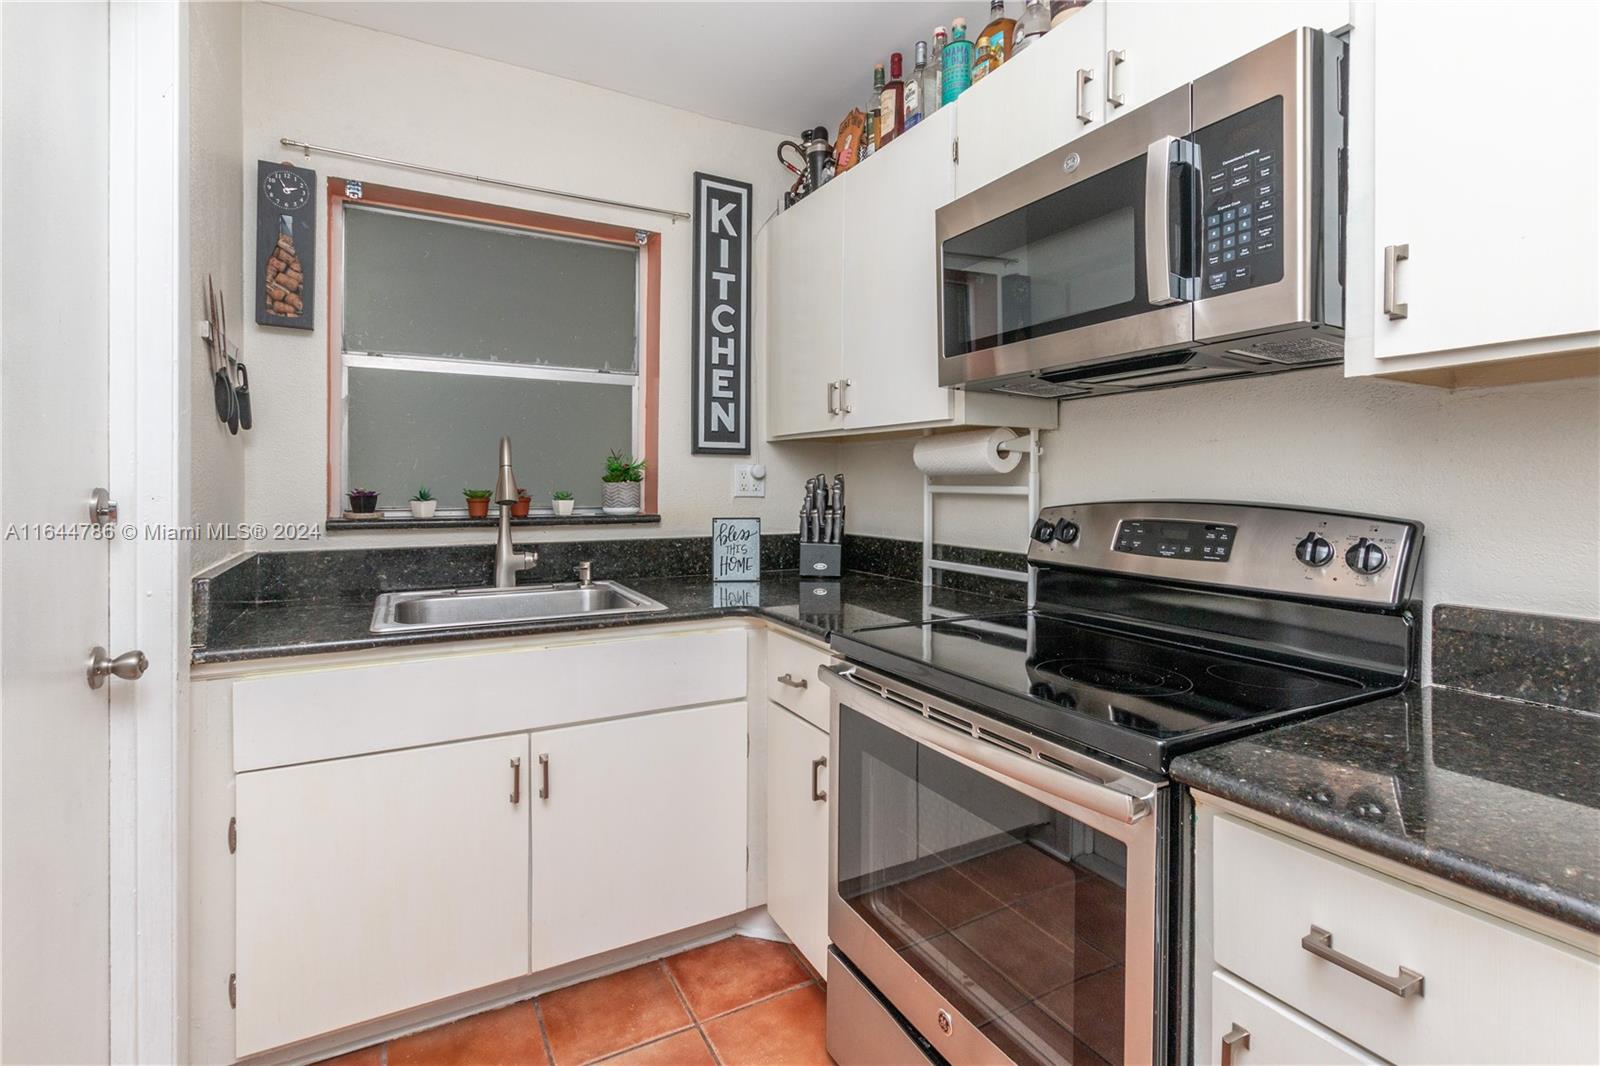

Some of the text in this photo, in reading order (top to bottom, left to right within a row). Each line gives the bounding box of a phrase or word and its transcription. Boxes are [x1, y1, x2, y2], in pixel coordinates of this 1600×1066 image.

[710, 198, 738, 433] KITCHEN
[726, 543, 748, 556] THIS
[720, 556, 753, 576] HOME
